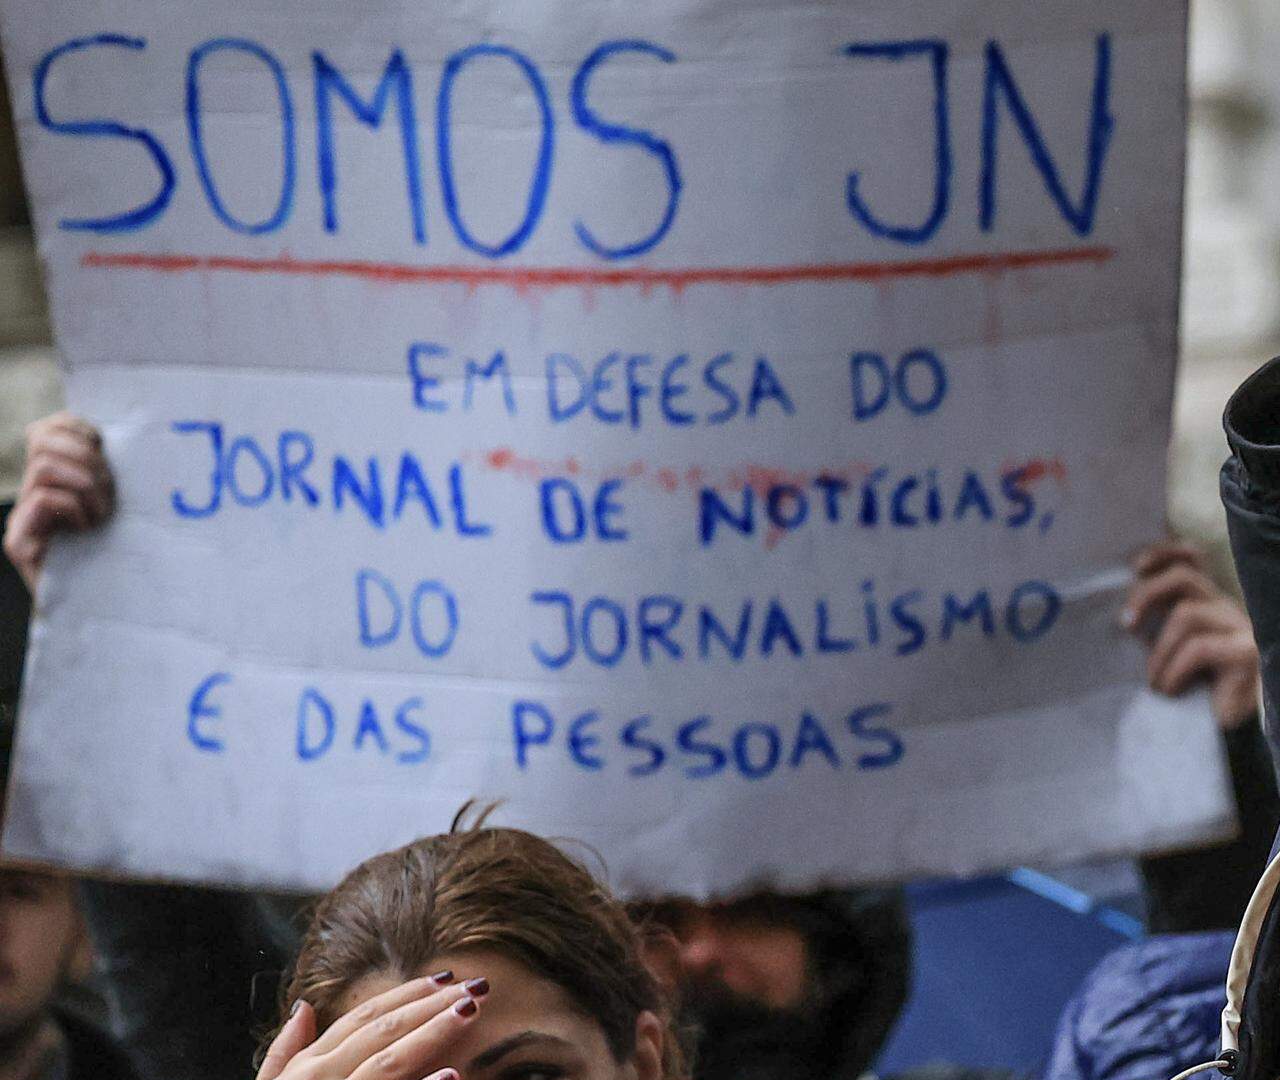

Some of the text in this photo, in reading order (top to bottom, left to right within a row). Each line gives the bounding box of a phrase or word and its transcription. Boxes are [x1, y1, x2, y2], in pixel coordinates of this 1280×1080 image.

[33, 34, 1115, 262] SOMOS JN
[407, 341, 950, 431] EM DEFESA DO
[170, 420, 493, 540] JORNAL
[537, 477, 631, 548] DE
[352, 569, 1066, 672] DO JORNALISMO
[185, 672, 908, 782] E DAS PESSOAS
